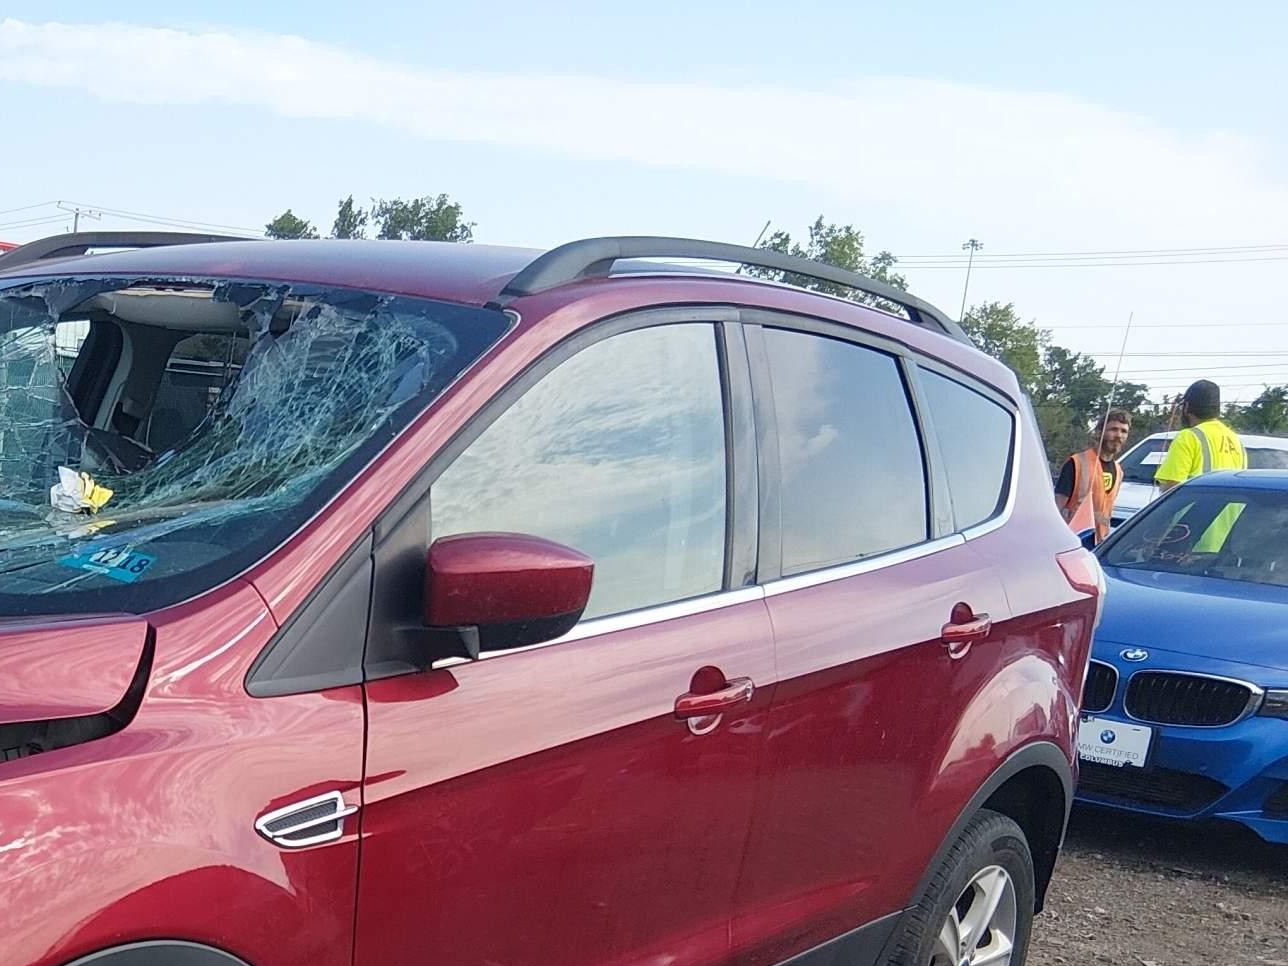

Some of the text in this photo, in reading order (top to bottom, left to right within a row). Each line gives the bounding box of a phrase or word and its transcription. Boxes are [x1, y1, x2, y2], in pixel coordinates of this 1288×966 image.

[118, 554, 150, 573] 18
[1095, 745, 1139, 759] CERTIFIED
[1080, 754, 1123, 767] COLUMBUS
